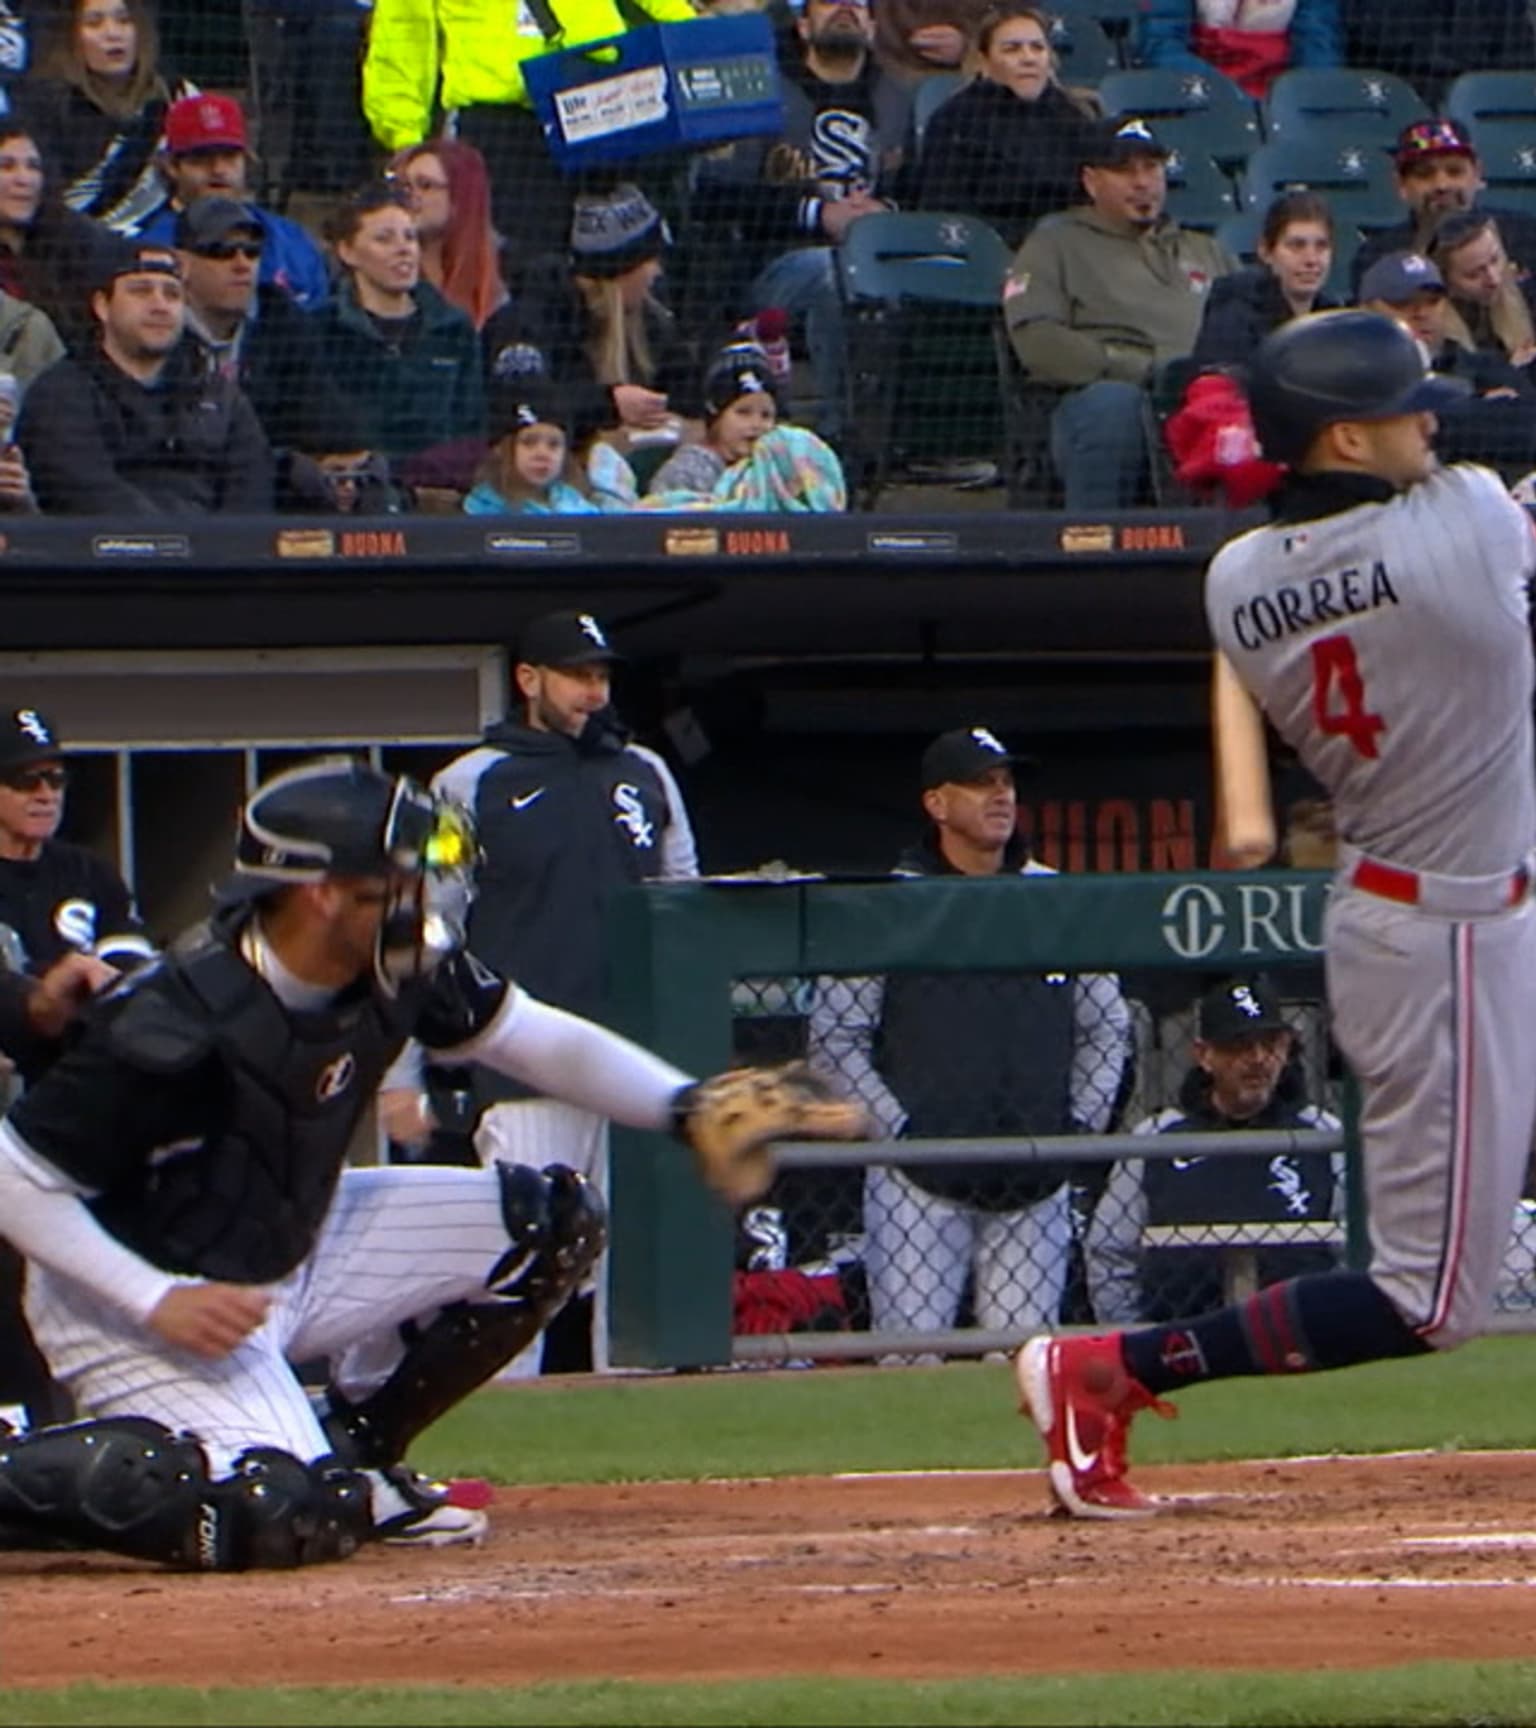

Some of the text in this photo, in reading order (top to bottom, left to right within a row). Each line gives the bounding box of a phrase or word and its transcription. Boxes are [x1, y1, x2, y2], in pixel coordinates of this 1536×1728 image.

[1232, 561, 1398, 649] CORREA
[1311, 634, 1388, 759] 4
[1236, 884, 1330, 954] RU
